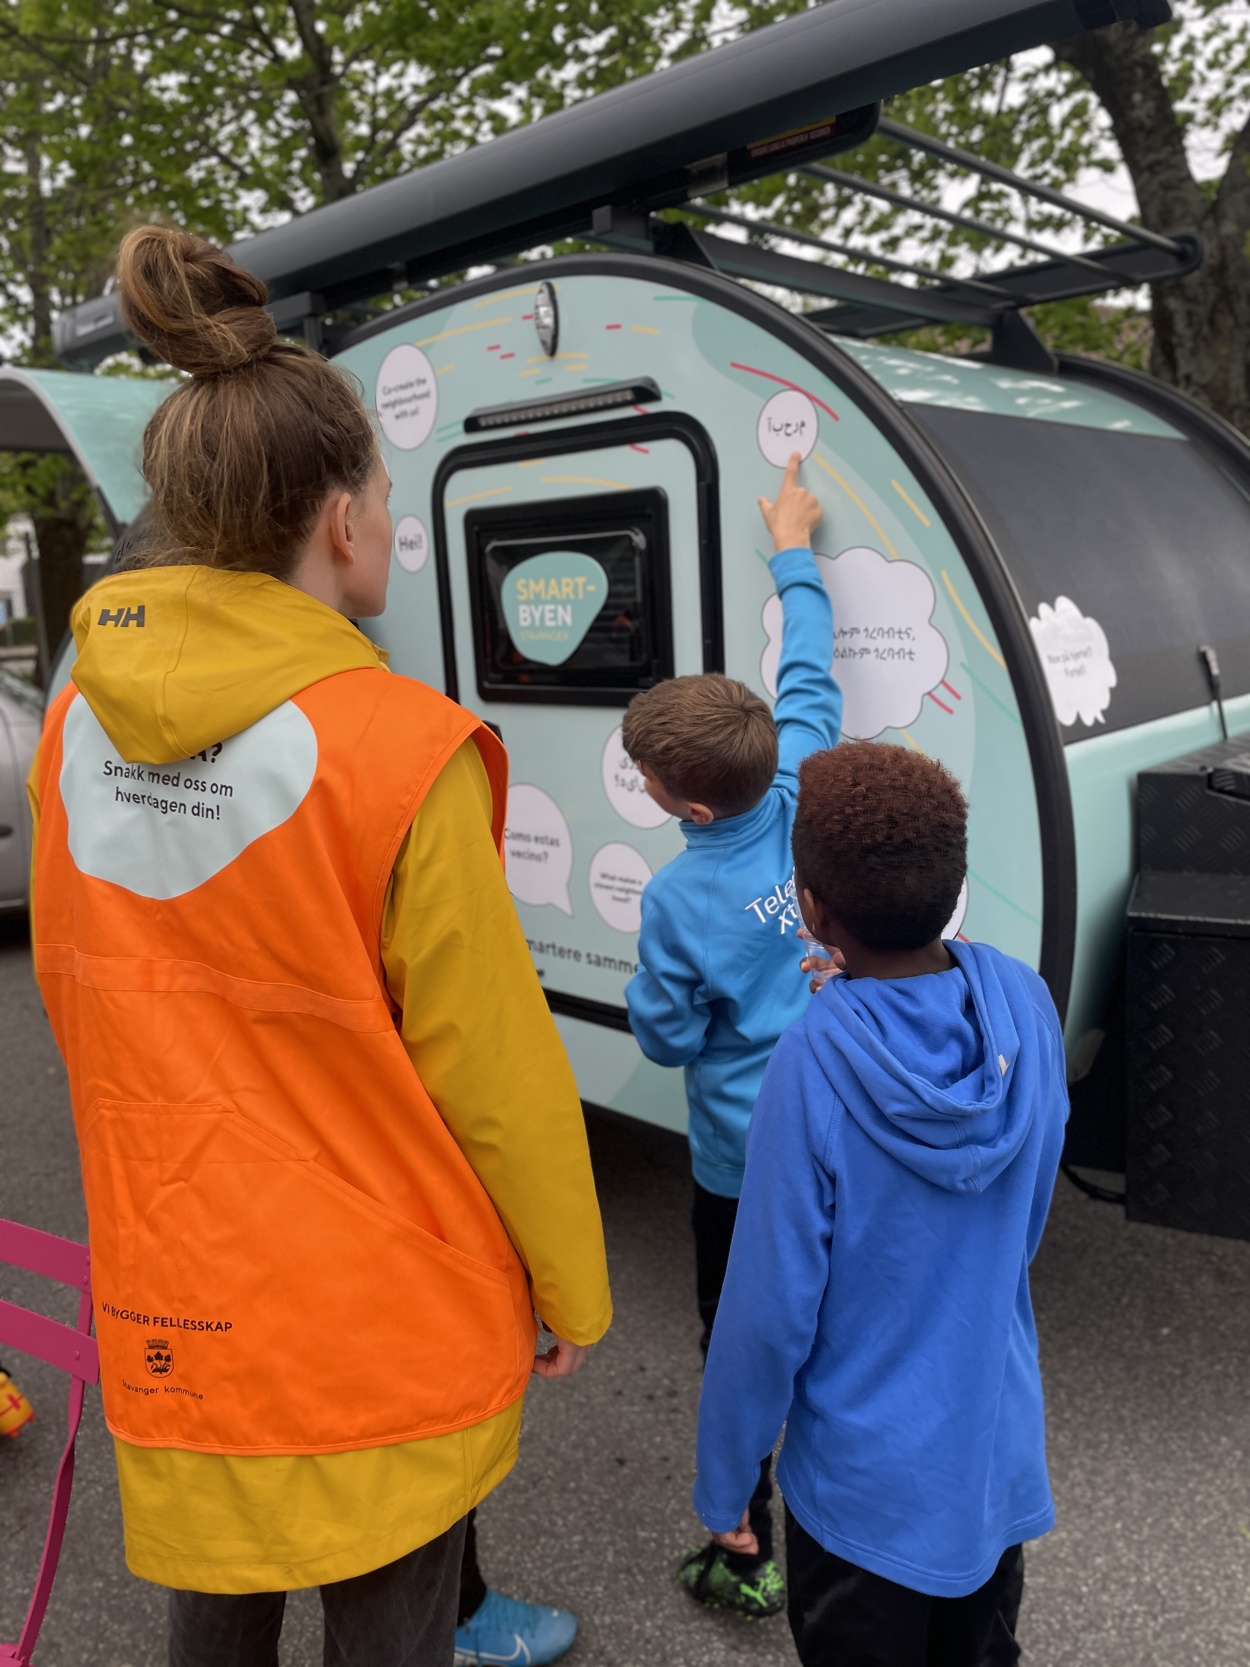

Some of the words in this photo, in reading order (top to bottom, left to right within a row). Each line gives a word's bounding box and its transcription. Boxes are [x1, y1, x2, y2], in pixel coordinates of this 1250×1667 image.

[516, 576, 596, 601] SMART-
[98, 605, 145, 628] HH
[518, 604, 572, 627] BYEN
[103, 760, 145, 781] Snakk
[148, 772, 181, 788] med
[183, 778, 207, 792] oss
[210, 783, 233, 797] om
[191, 801, 220, 820] din!
[744, 866, 796, 924] Tele
[102, 1301, 110, 1314] VI
[111, 1306, 150, 1326] BYGGER
[153, 1316, 233, 1332] FELLESSKAP
[164, 1385, 204, 1400] kommune
